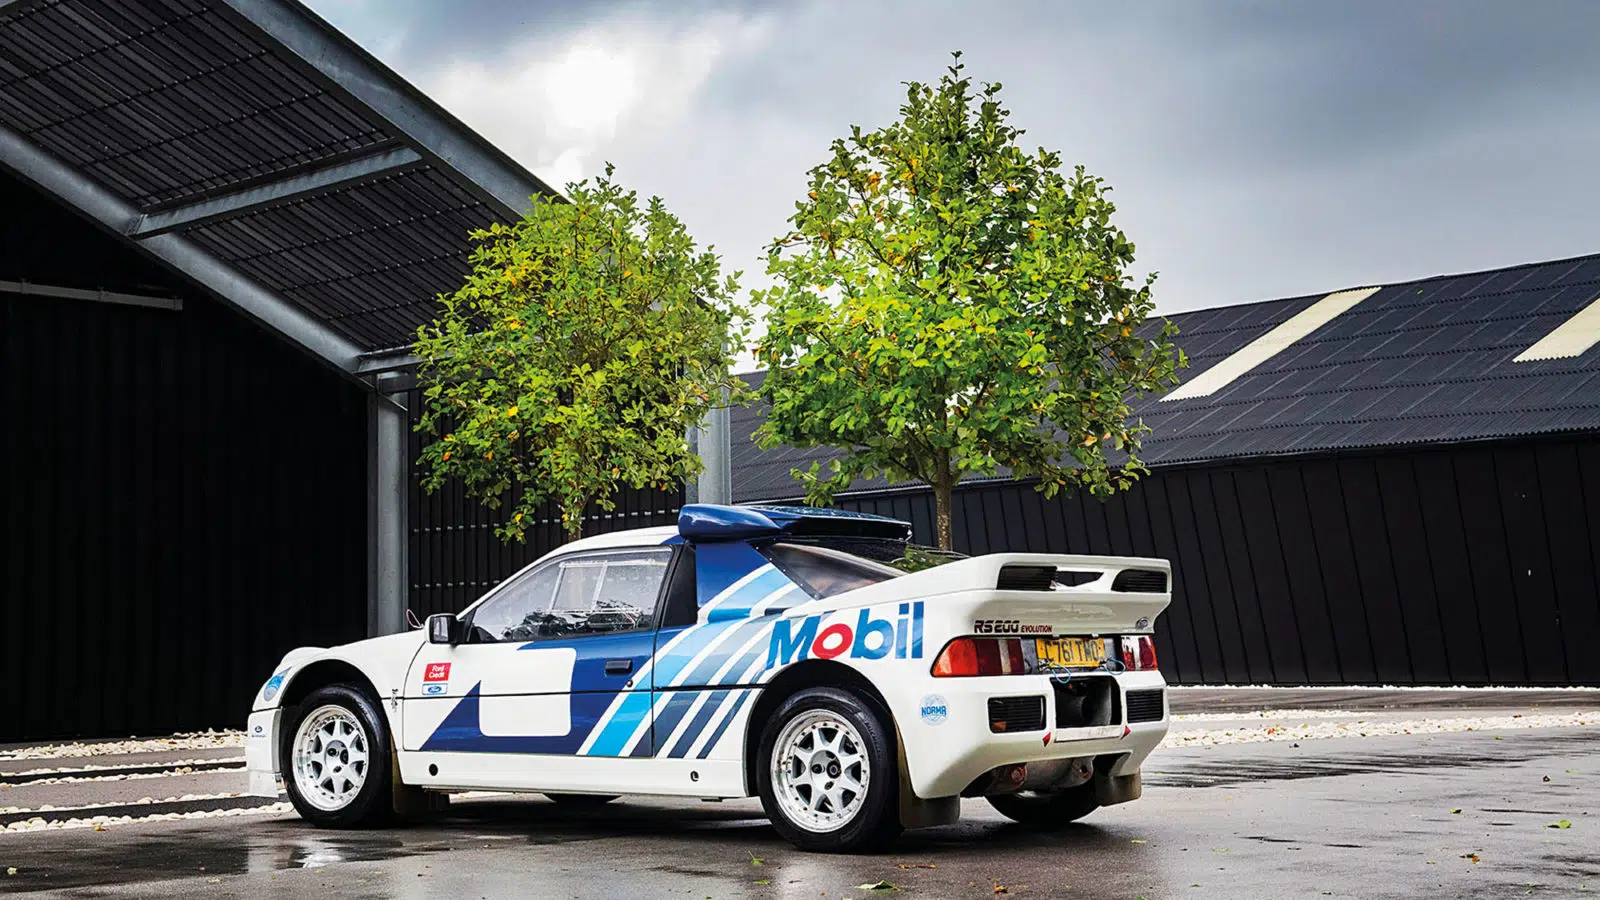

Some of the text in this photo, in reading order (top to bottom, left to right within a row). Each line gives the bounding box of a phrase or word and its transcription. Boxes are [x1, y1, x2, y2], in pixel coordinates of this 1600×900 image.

[1020, 625, 1052, 633] EVOLUTION
[765, 601, 924, 670] Mobil
[921, 705, 947, 717] NORMA
